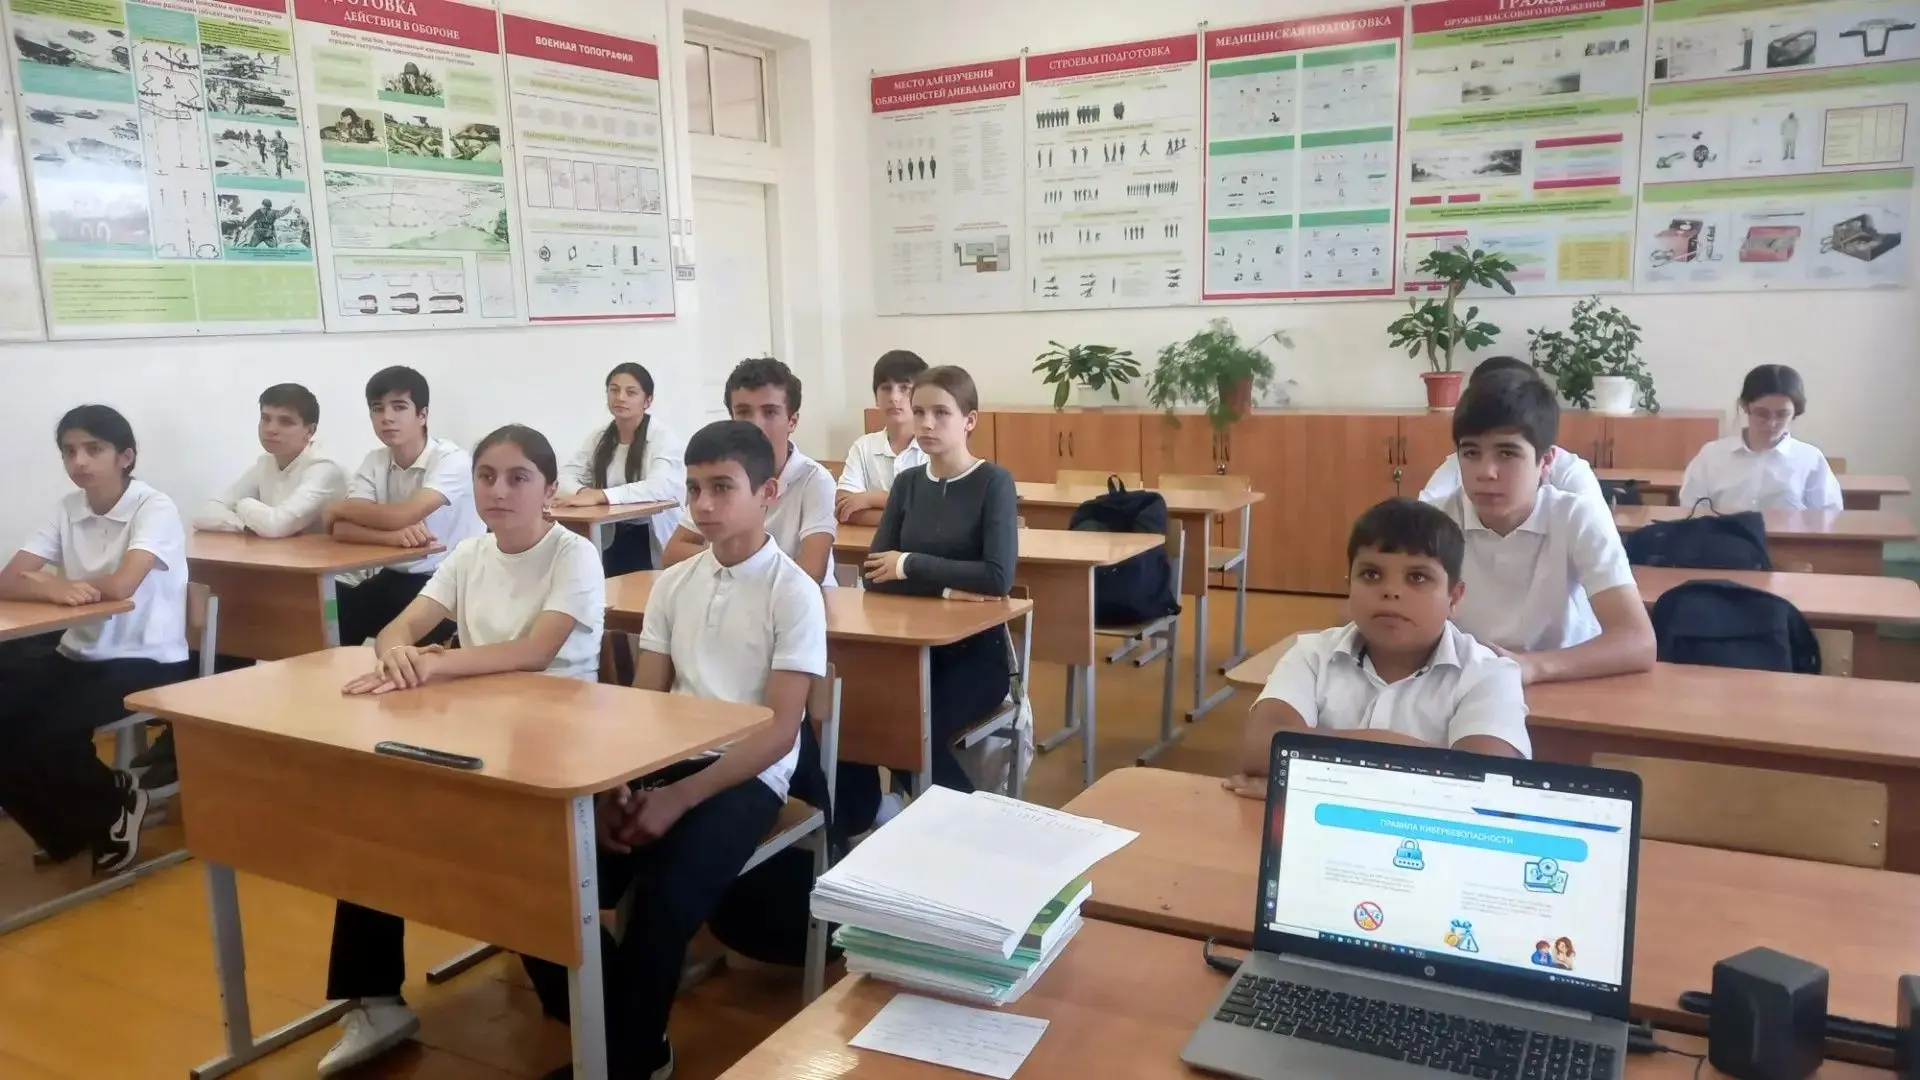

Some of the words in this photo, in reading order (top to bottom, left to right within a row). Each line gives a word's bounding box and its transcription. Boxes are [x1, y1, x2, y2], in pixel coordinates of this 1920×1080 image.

[344, 10, 402, 30] ДЕЙСТВИЯ
[403, 21, 411, 31] В
[411, 23, 460, 40] ОБОРОНЕ
[1444, 15, 1481, 27] ОРУЖИЕ
[1483, 8, 1542, 21] МАССОВОГО
[1544, 1, 1606, 15] ПОРАЖЕНИЯ
[1215, 28, 1305, 47] МЕДИЦИНСКАЯ
[1306, 15, 1392, 36] ПОДГОТОВКА
[535, 36, 577, 53] ВОЕННАЯ
[578, 44, 634, 62] ТОПОГРАФИЯ
[1049, 55, 1099, 70] СТРОЕВАЯ
[1100, 46, 1171, 63] ПОДГОТОВКА
[894, 78, 925, 90] МЕСТО
[925, 75, 944, 87] ДЛЯ
[945, 69, 994, 83] ИЗУЧЕНИЯ
[875, 88, 946, 106] ОБЯЗАННОСТЕЙ
[947, 80, 1016, 98] ДНЕВАЛЬНОГО
[1380, 819, 1418, 832] ПРАВИЛА
